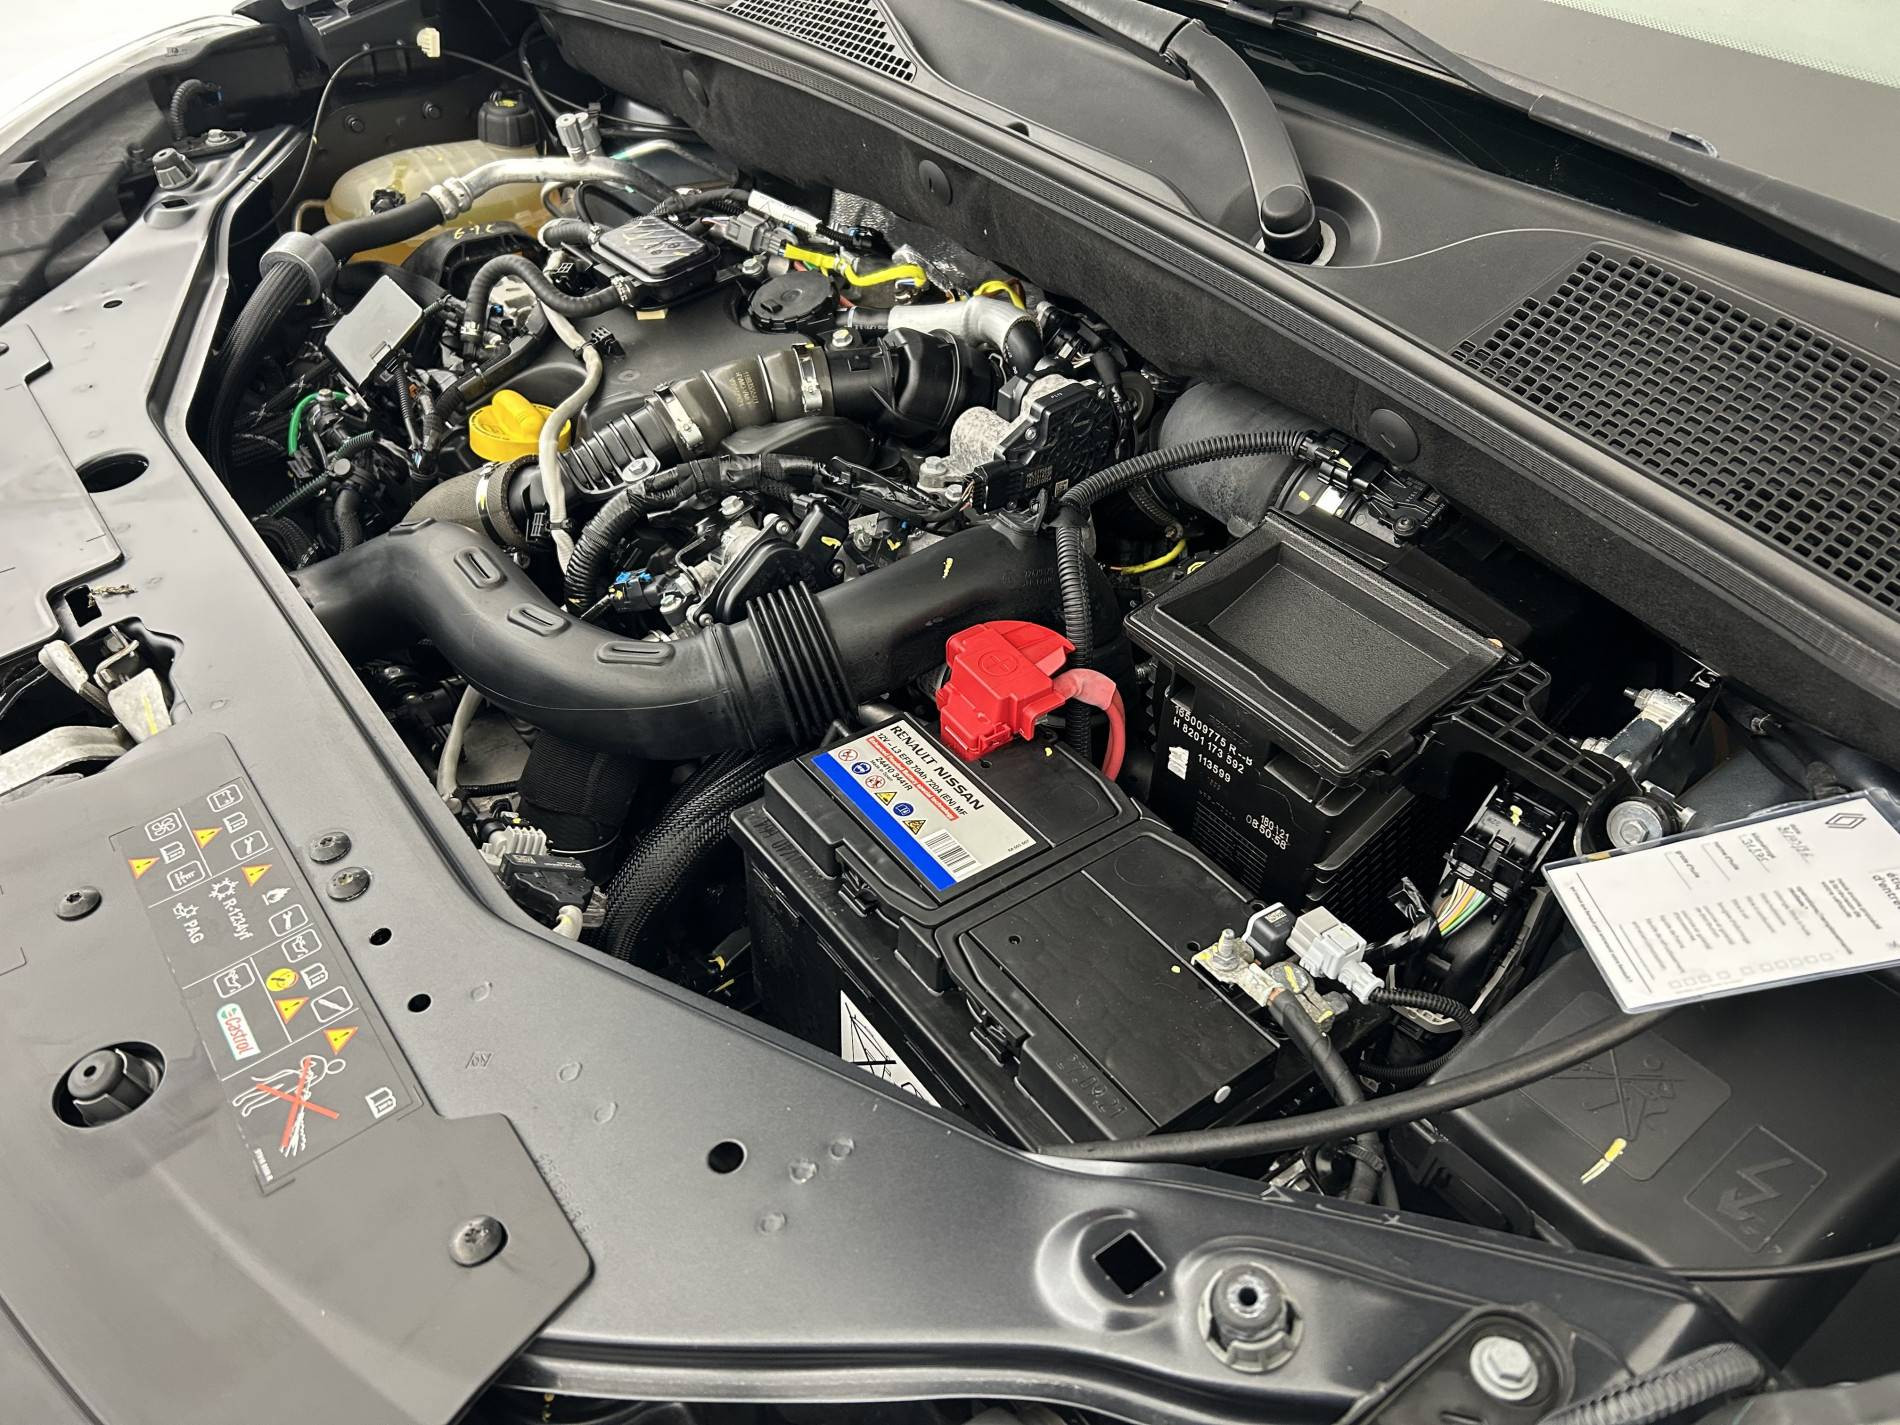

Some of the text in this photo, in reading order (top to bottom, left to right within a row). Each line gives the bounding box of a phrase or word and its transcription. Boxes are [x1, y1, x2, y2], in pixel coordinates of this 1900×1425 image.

[1173, 717, 1245, 774] H 8201 173 592
[875, 757, 913, 792] 24410 3441R
[890, 725, 984, 811] RENAULT NISSAN
[891, 746, 902, 755] L3
[899, 753, 914, 766] EFB
[911, 764, 928, 780] 70Ah
[926, 778, 942, 795] 720A
[940, 793, 956, 808] (EN)
[954, 805, 968, 816] MF
[1198, 754, 1231, 782] 113599
[184, 919, 204, 944] PAG
[226, 1015, 251, 1054] Castrol
